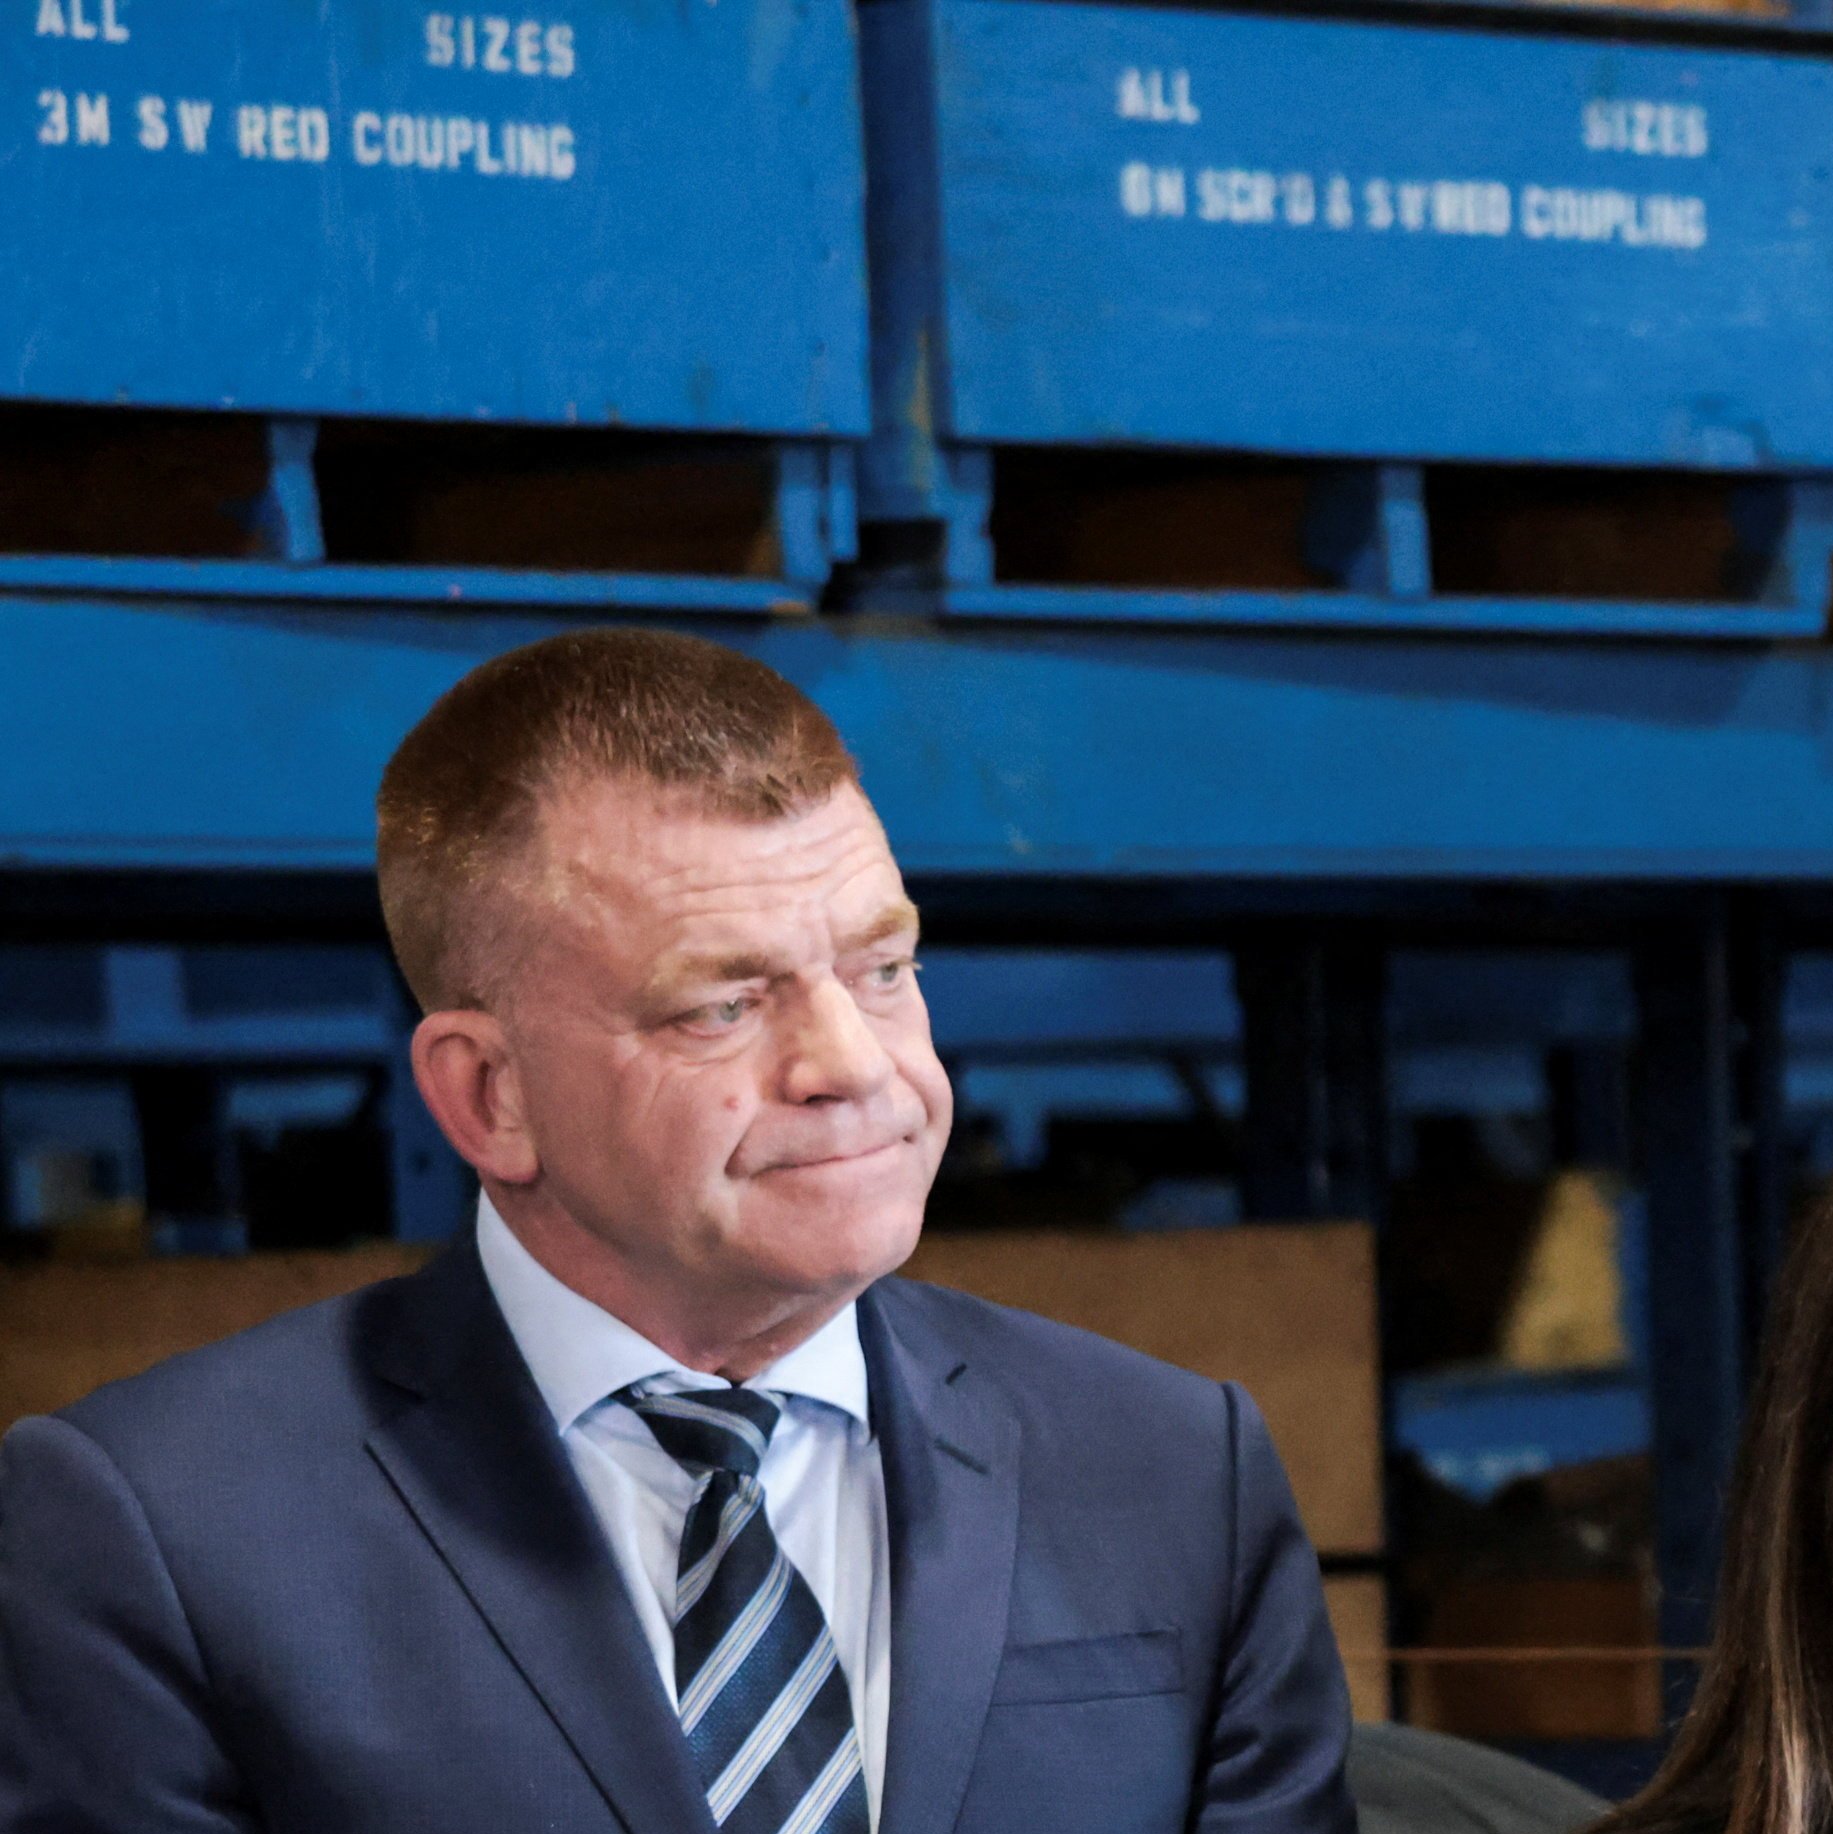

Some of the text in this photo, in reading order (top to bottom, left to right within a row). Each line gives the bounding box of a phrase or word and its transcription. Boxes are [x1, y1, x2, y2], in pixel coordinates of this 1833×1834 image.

[424, 12, 577, 80] SIZES
[37, 89, 112, 147] 3M
[235, 104, 331, 163] RED
[351, 110, 578, 182] COUPLING
[1115, 66, 1710, 159] ALL SIZES
